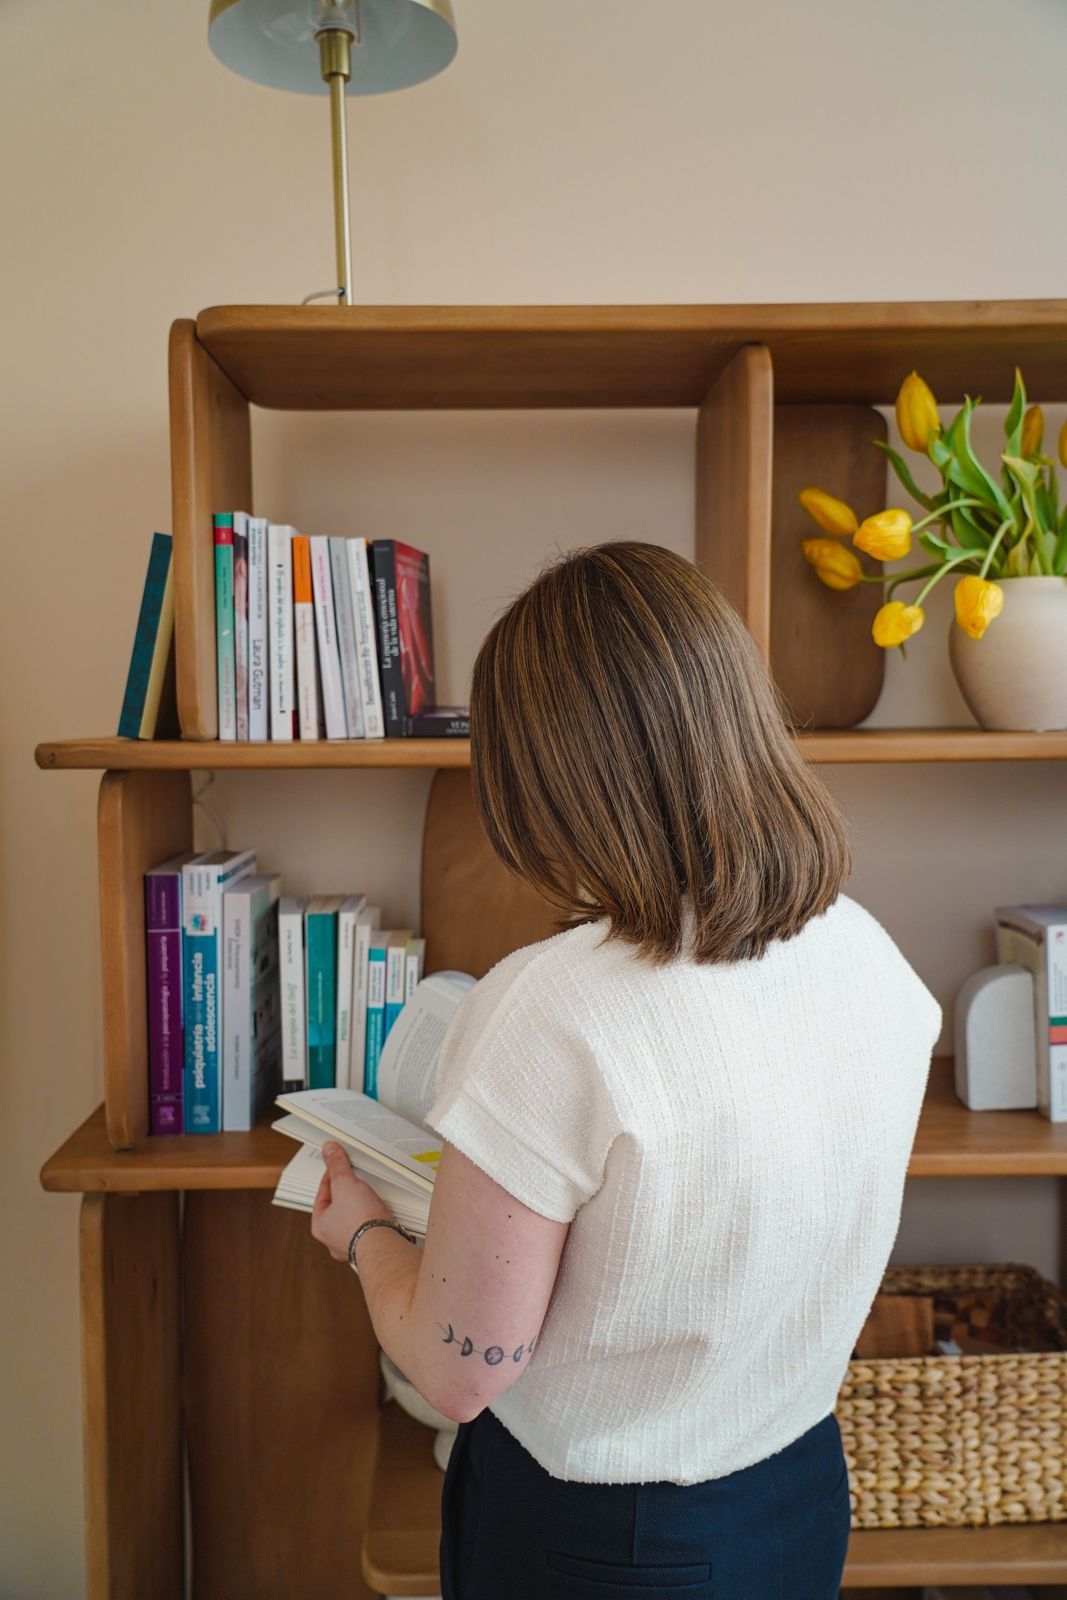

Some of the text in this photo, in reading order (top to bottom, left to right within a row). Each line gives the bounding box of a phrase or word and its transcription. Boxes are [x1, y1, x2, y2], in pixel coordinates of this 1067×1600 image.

[376, 578, 392, 668] La memoria emocional
[388, 618, 397, 636] vida
[253, 639, 264, 710] Laura Gutman
[390, 646, 399, 656] de
[159, 935, 169, 972] psiquiatría
[192, 952, 204, 1002] infancia
[160, 986, 170, 1035] psicopatología
[204, 973, 215, 1052] adolescencia
[288, 983, 298, 1060] La terapia del Self
[161, 1048, 170, 1090] Introducción
[192, 1024, 206, 1088] psiquiatría
